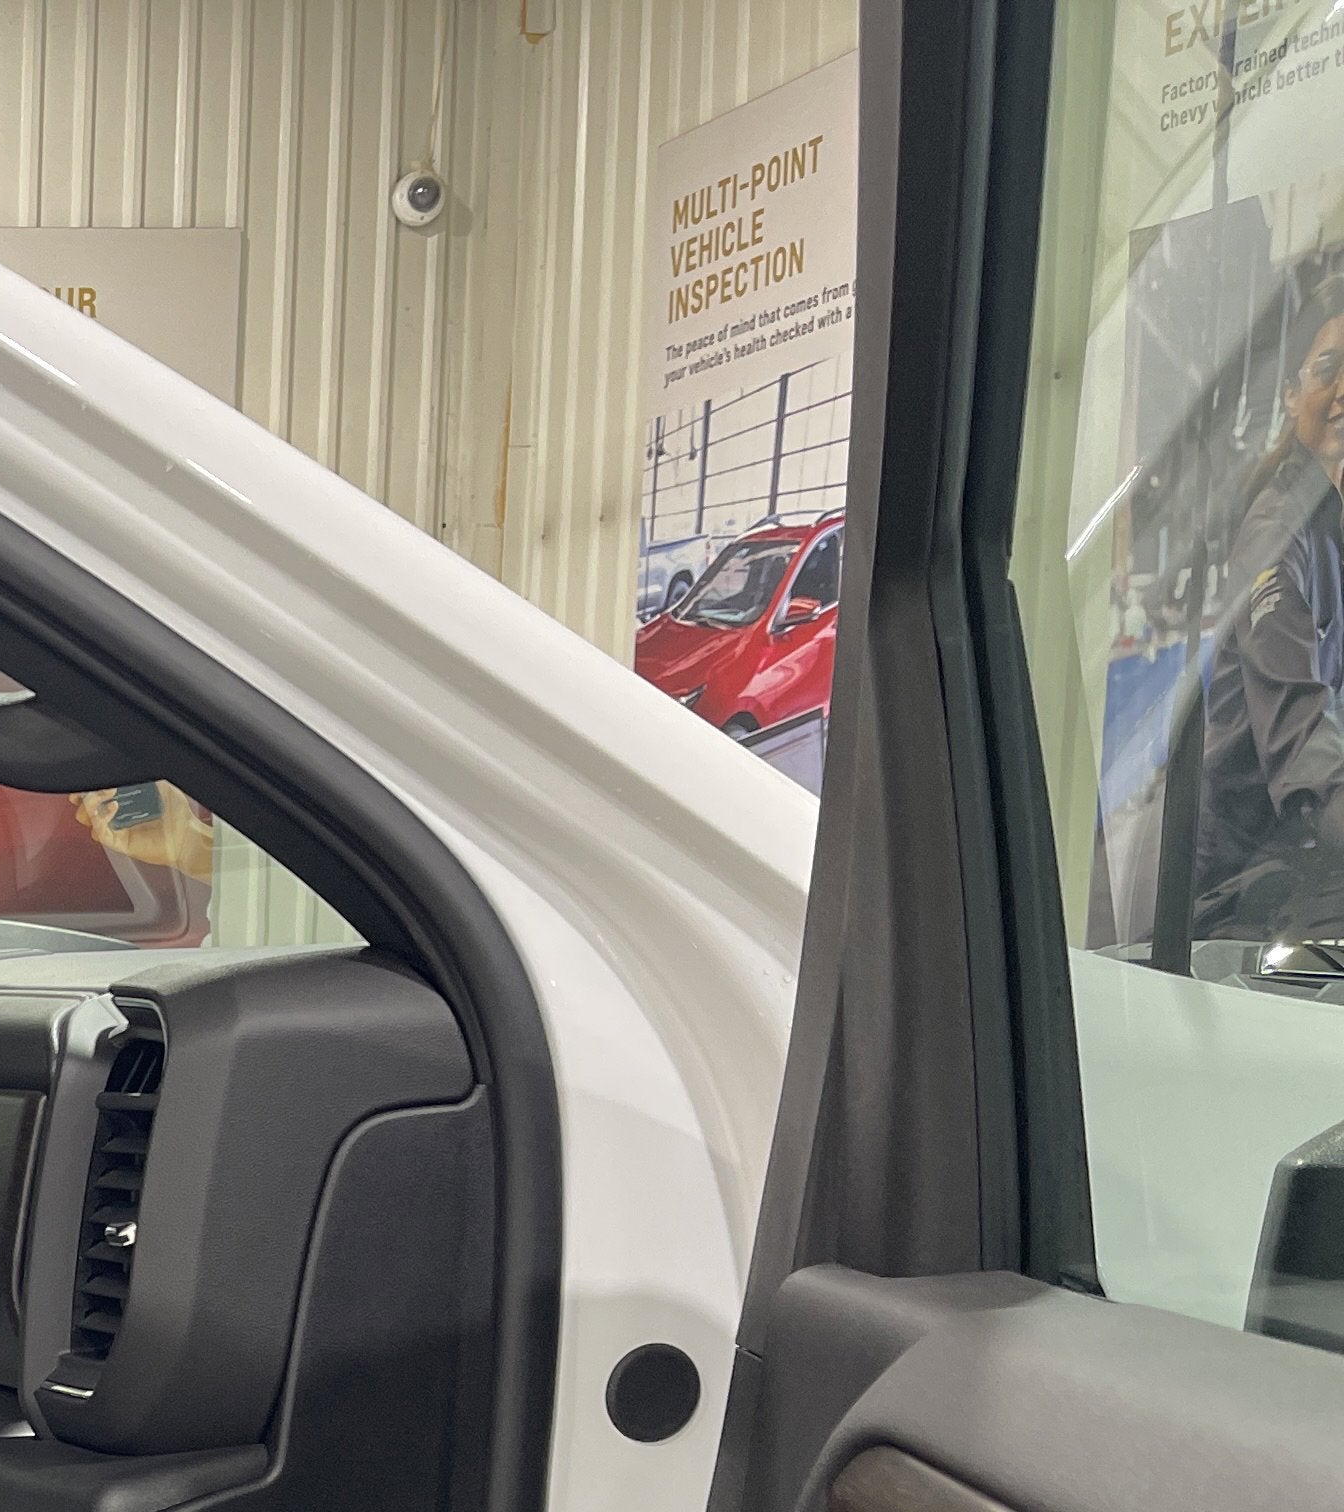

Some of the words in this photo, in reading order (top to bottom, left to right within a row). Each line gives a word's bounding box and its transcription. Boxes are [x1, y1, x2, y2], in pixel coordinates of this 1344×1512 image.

[1160, 102, 1209, 131] Chevy
[1276, 57, 1330, 90] better
[1162, 71, 1218, 104] Factory
[1233, 38, 1288, 76] rained
[672, 134, 824, 234] MULTI-POINT
[671, 207, 765, 278] VEHICLE
[40, 286, 97, 318] UR
[668, 238, 805, 324] INSPECTION
[664, 366, 687, 389] your
[689, 347, 731, 375] vehicle's
[734, 334, 767, 360] health
[769, 315, 814, 349] checked
[818, 306, 842, 329] with
[846, 306, 852, 319] a
[665, 344, 683, 362] The
[686, 334, 714, 360] peace
[717, 323, 729, 342] of
[730, 313, 756, 338] mind
[759, 306, 781, 328] that
[783, 294, 819, 318] comes
[822, 283, 849, 305] from
